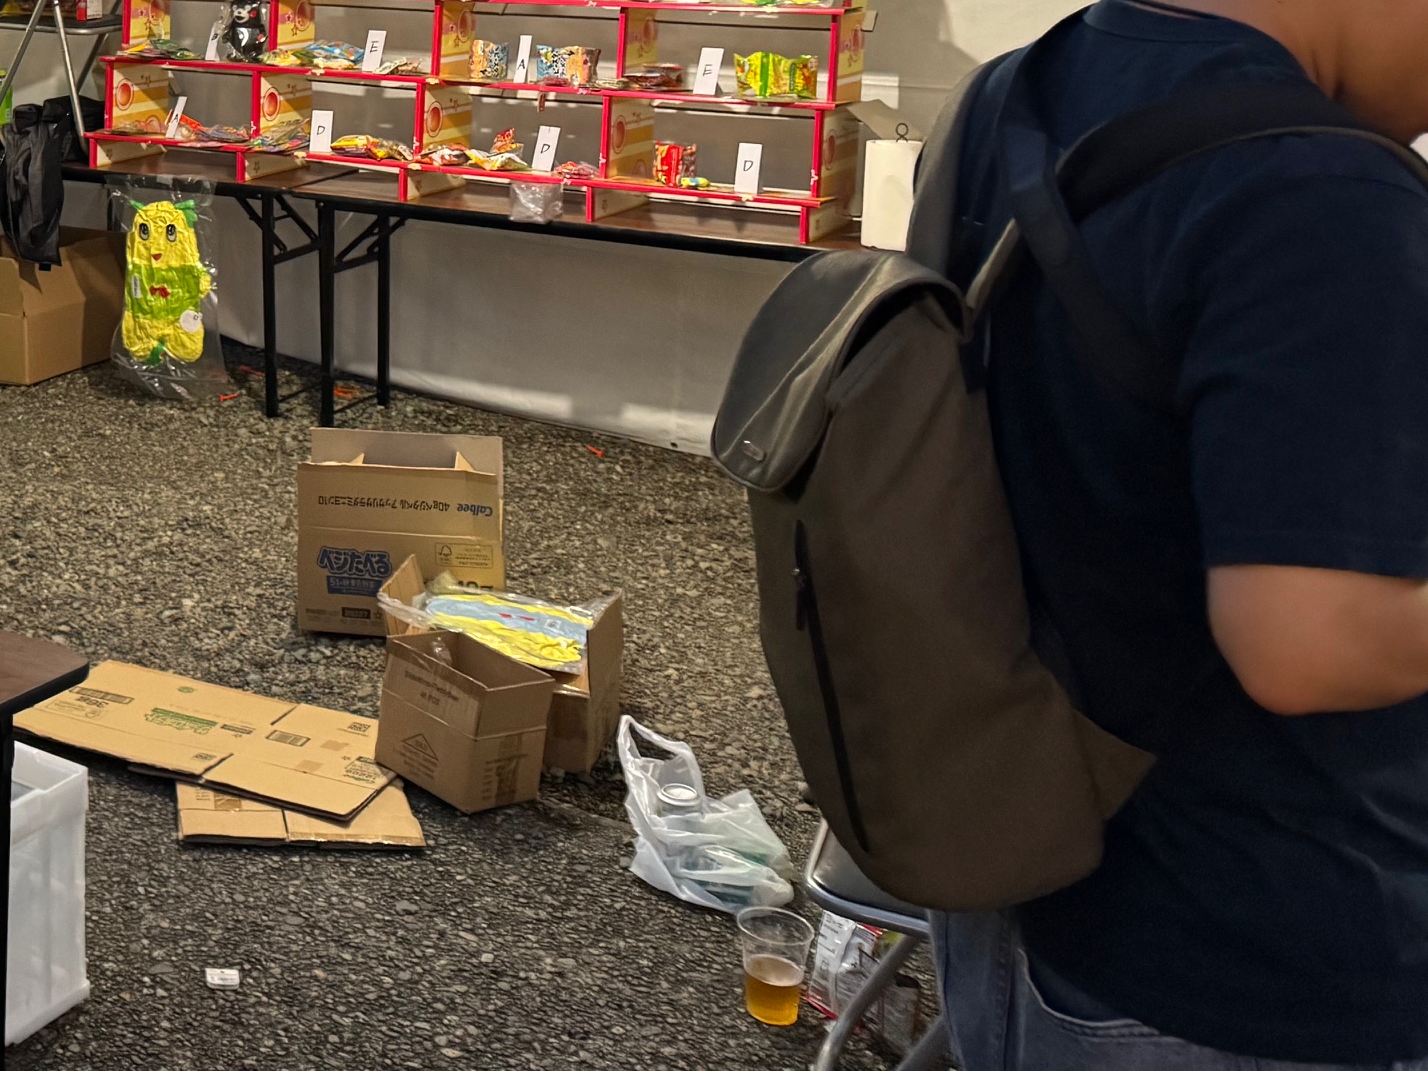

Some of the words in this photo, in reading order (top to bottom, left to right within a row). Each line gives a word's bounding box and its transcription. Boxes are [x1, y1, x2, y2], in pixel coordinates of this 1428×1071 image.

[369, 40, 380, 53] E
[517, 59, 527, 70] A
[701, 64, 713, 77] E
[316, 125, 326, 136] D
[540, 143, 551, 154] D
[742, 160, 754, 172] D
[456, 502, 494, 517] Calbee
[317, 546, 393, 577] ベジたべる
